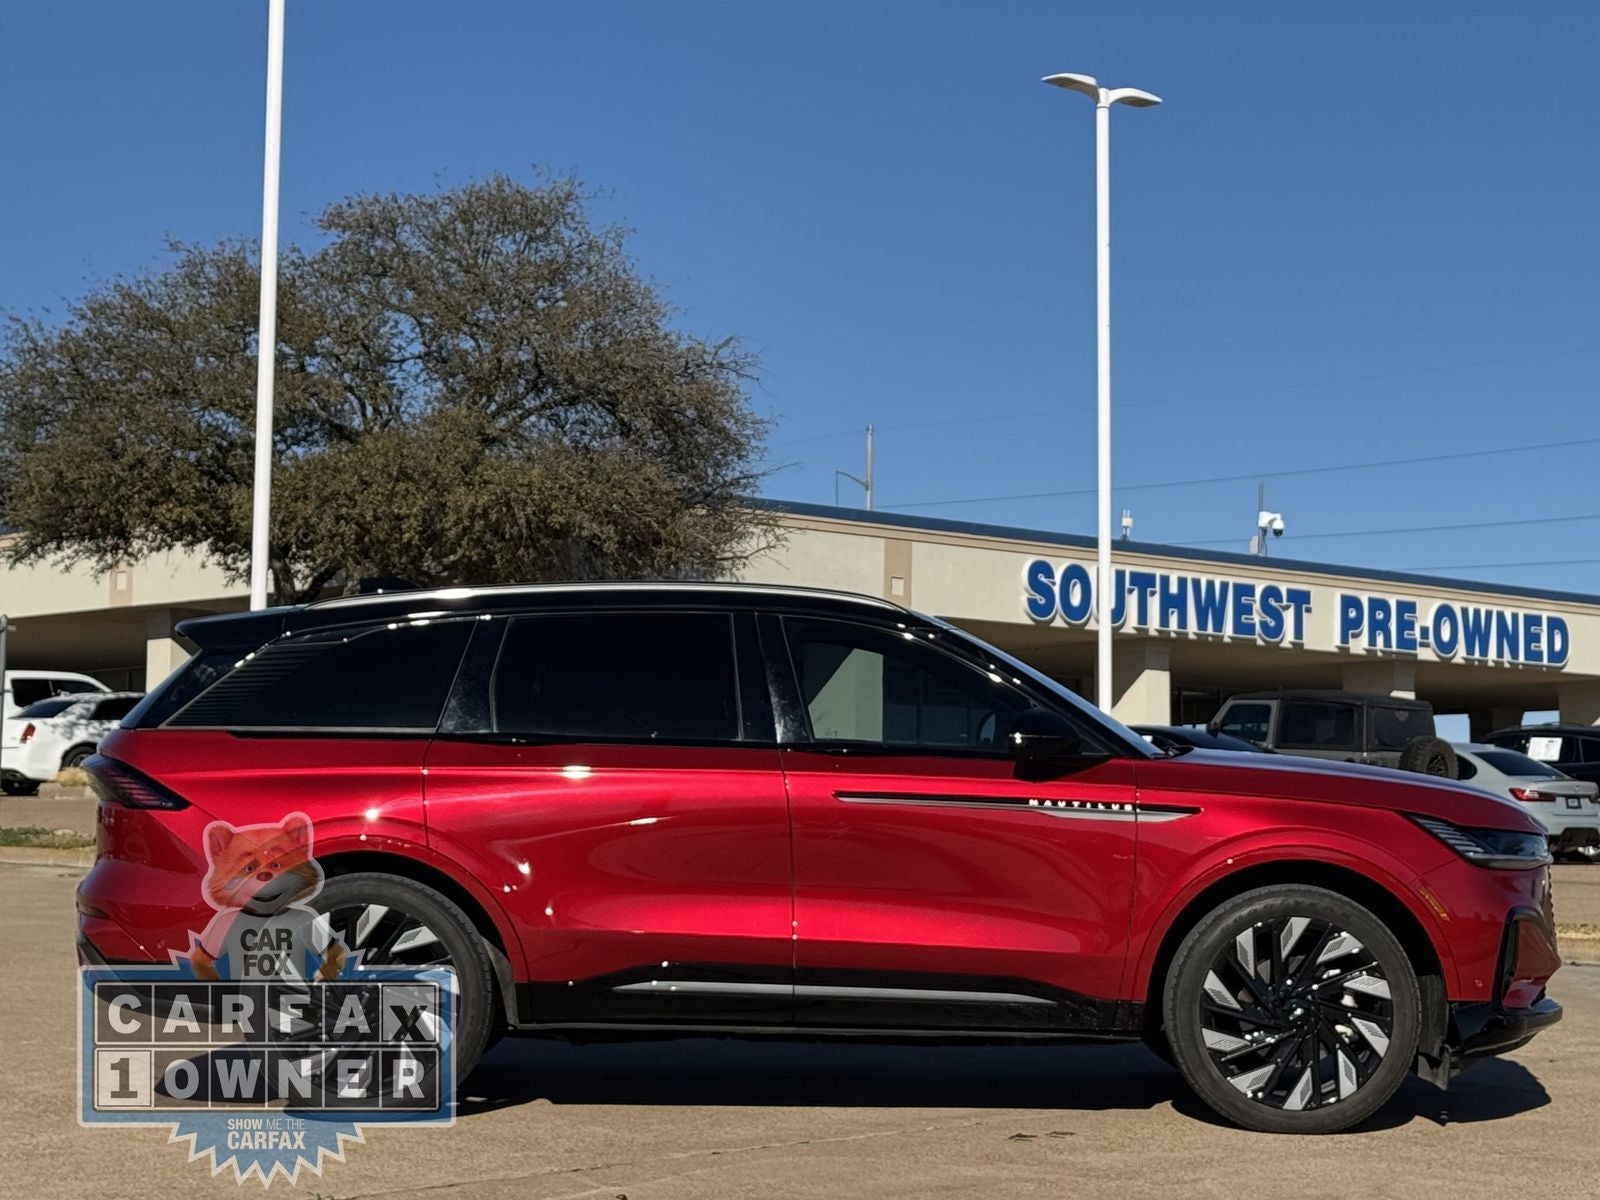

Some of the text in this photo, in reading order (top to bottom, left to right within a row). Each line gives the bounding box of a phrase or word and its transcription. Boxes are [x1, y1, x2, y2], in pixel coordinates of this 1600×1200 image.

[1023, 559, 1571, 668] SOUTHWEST PRE-OWNED
[1029, 799, 1132, 811] NAUTILUS
